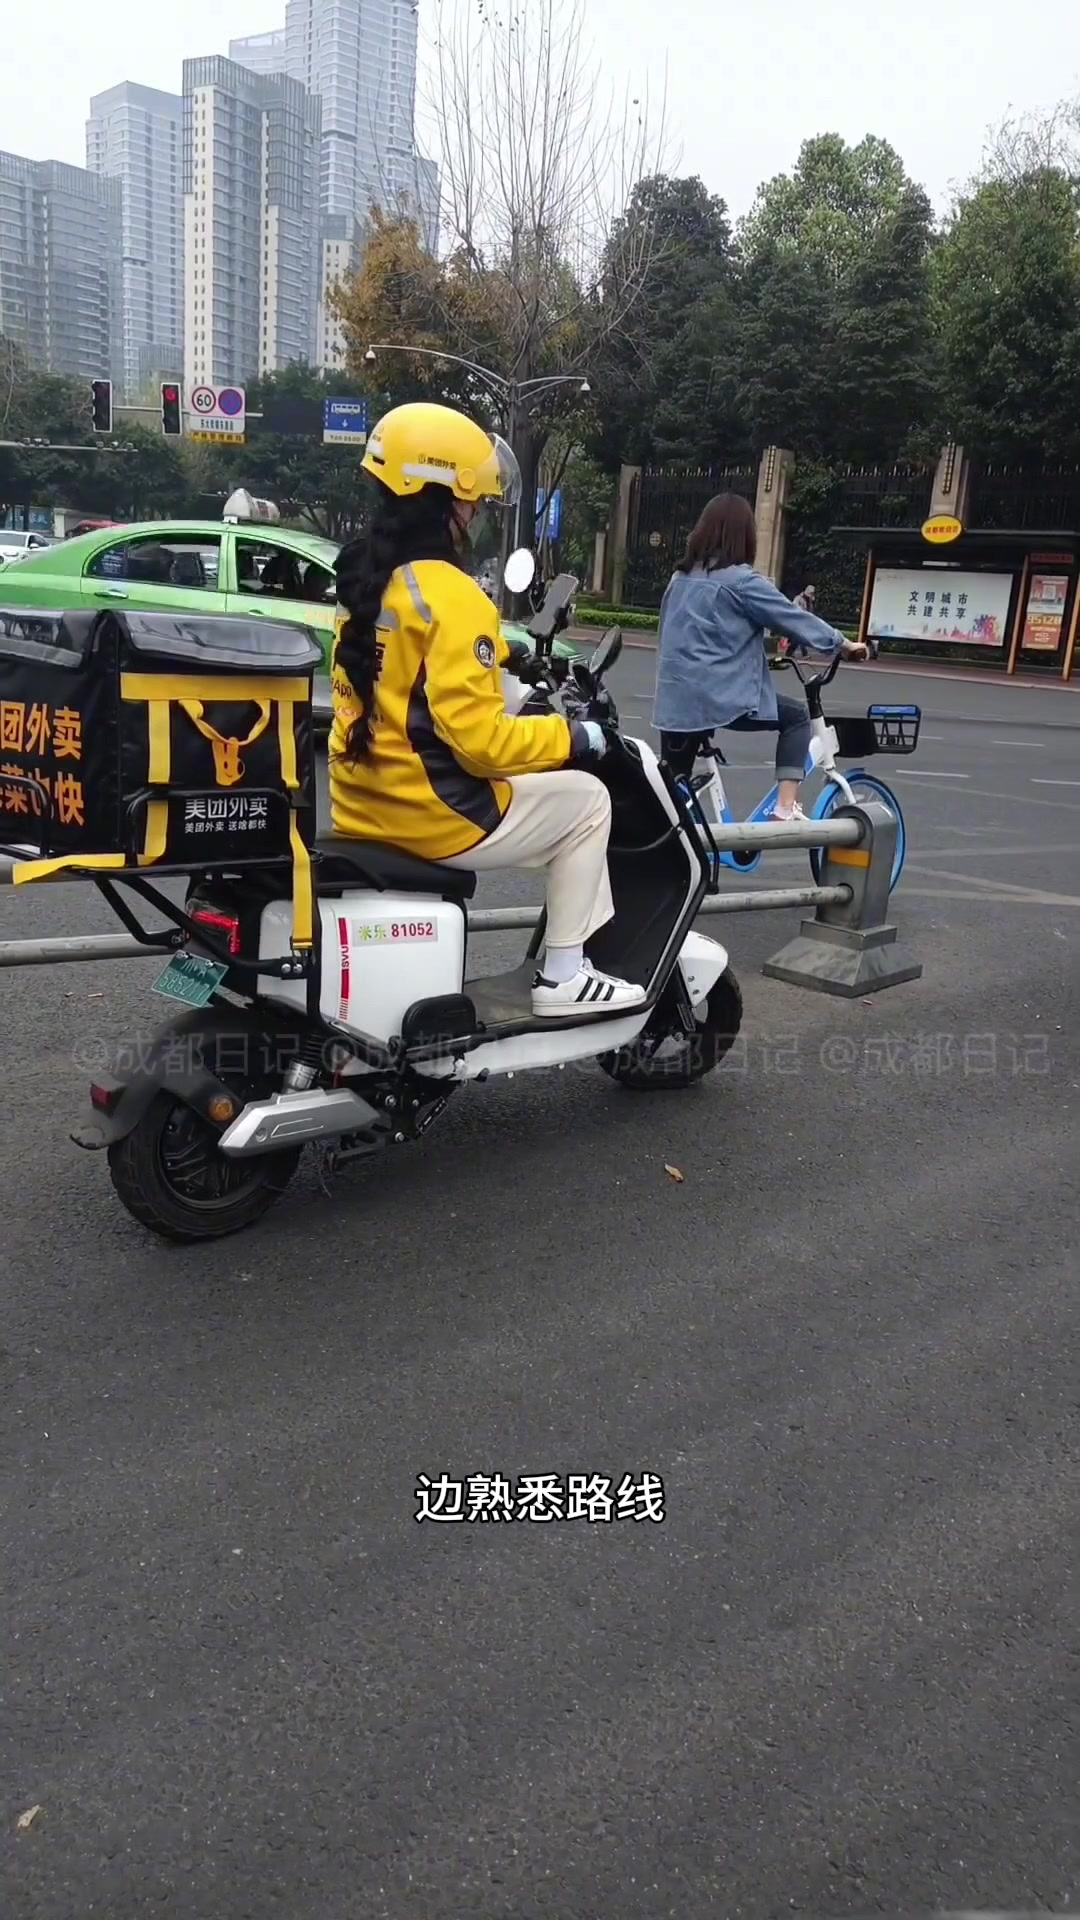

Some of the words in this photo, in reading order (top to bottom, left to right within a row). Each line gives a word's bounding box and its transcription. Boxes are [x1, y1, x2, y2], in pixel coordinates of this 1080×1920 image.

[197, 394, 211, 407] 60
[909, 590, 968, 605] 文明城市
[907, 604, 966, 620] 共建共享
[0, 700, 82, 761] 团外卖
[184, 797, 268, 820] 美团外卖
[184, 821, 225, 834] 美团外卖
[228, 819, 267, 832] 送啥都快
[391, 922, 433, 938] 81052
